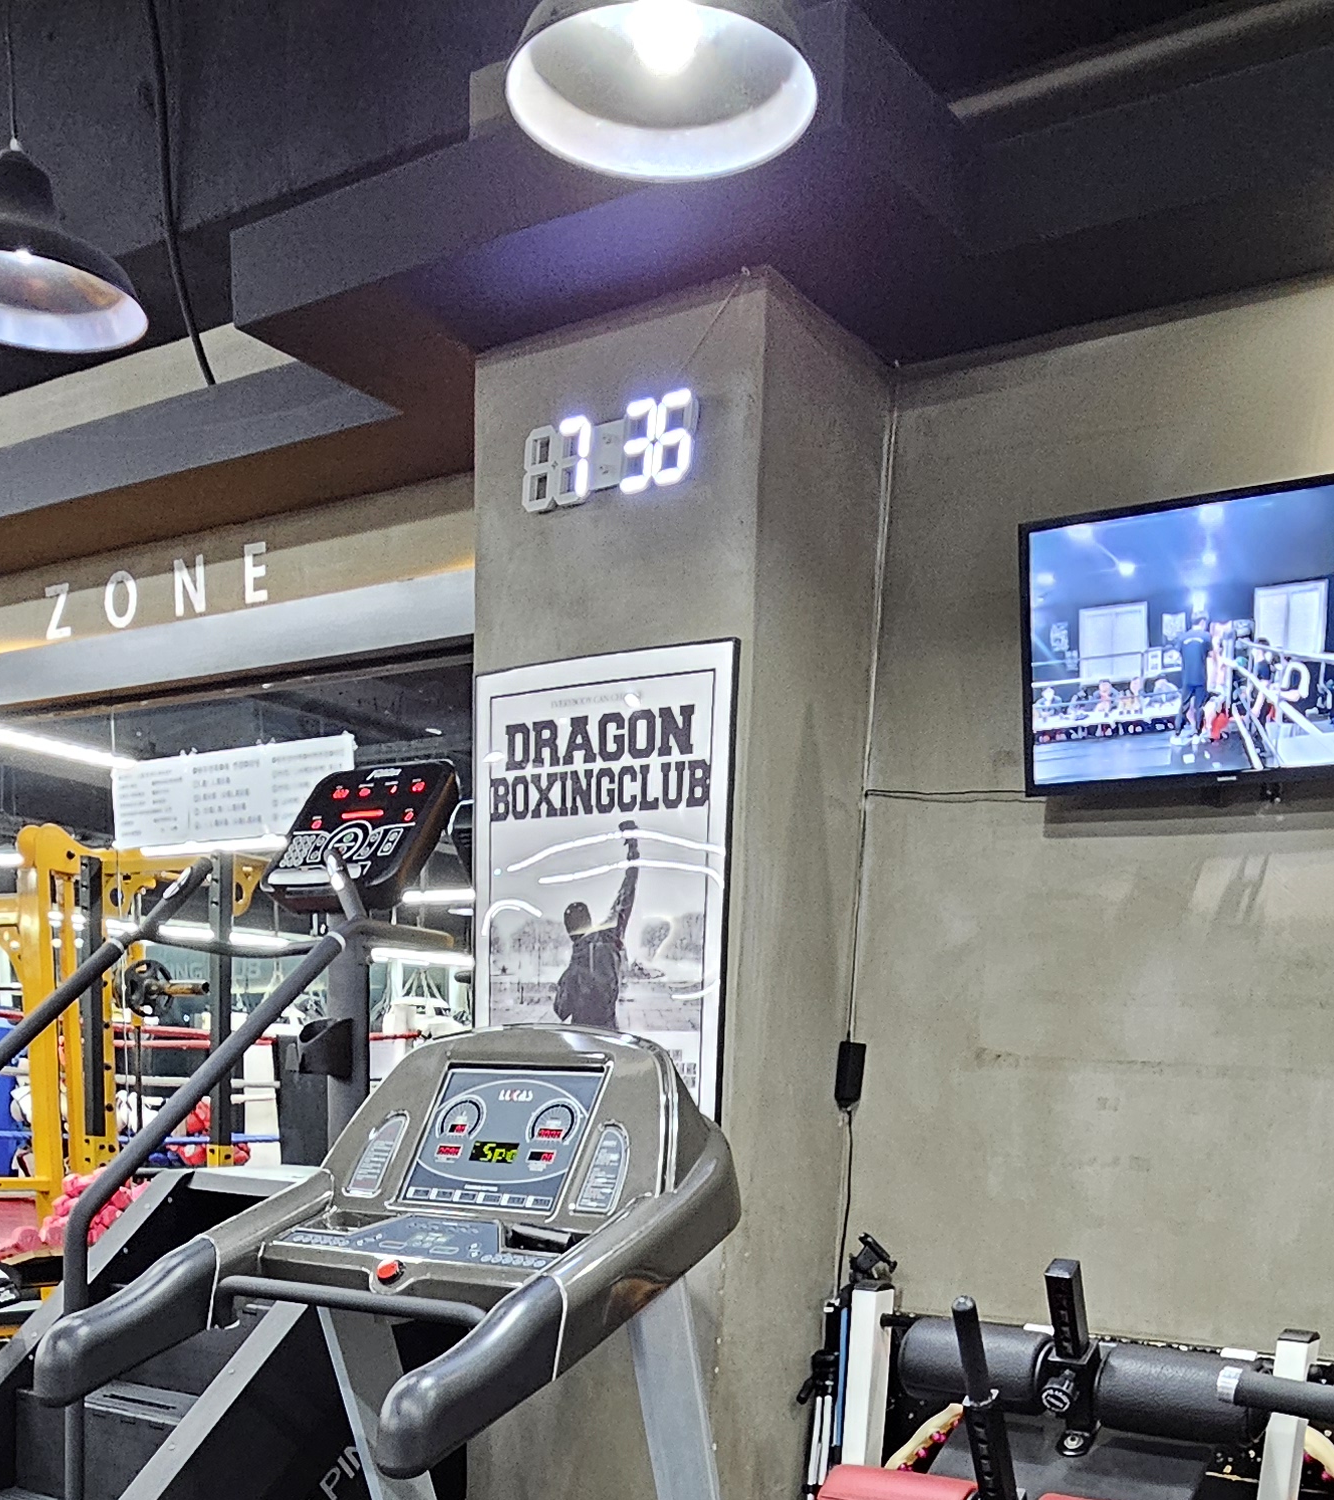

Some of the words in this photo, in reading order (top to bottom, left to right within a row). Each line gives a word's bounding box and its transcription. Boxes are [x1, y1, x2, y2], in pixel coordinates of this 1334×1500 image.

[44, 540, 269, 641] ZONE
[505, 703, 695, 772] DRAGON
[489, 759, 711, 822] BOXINGCLUB
